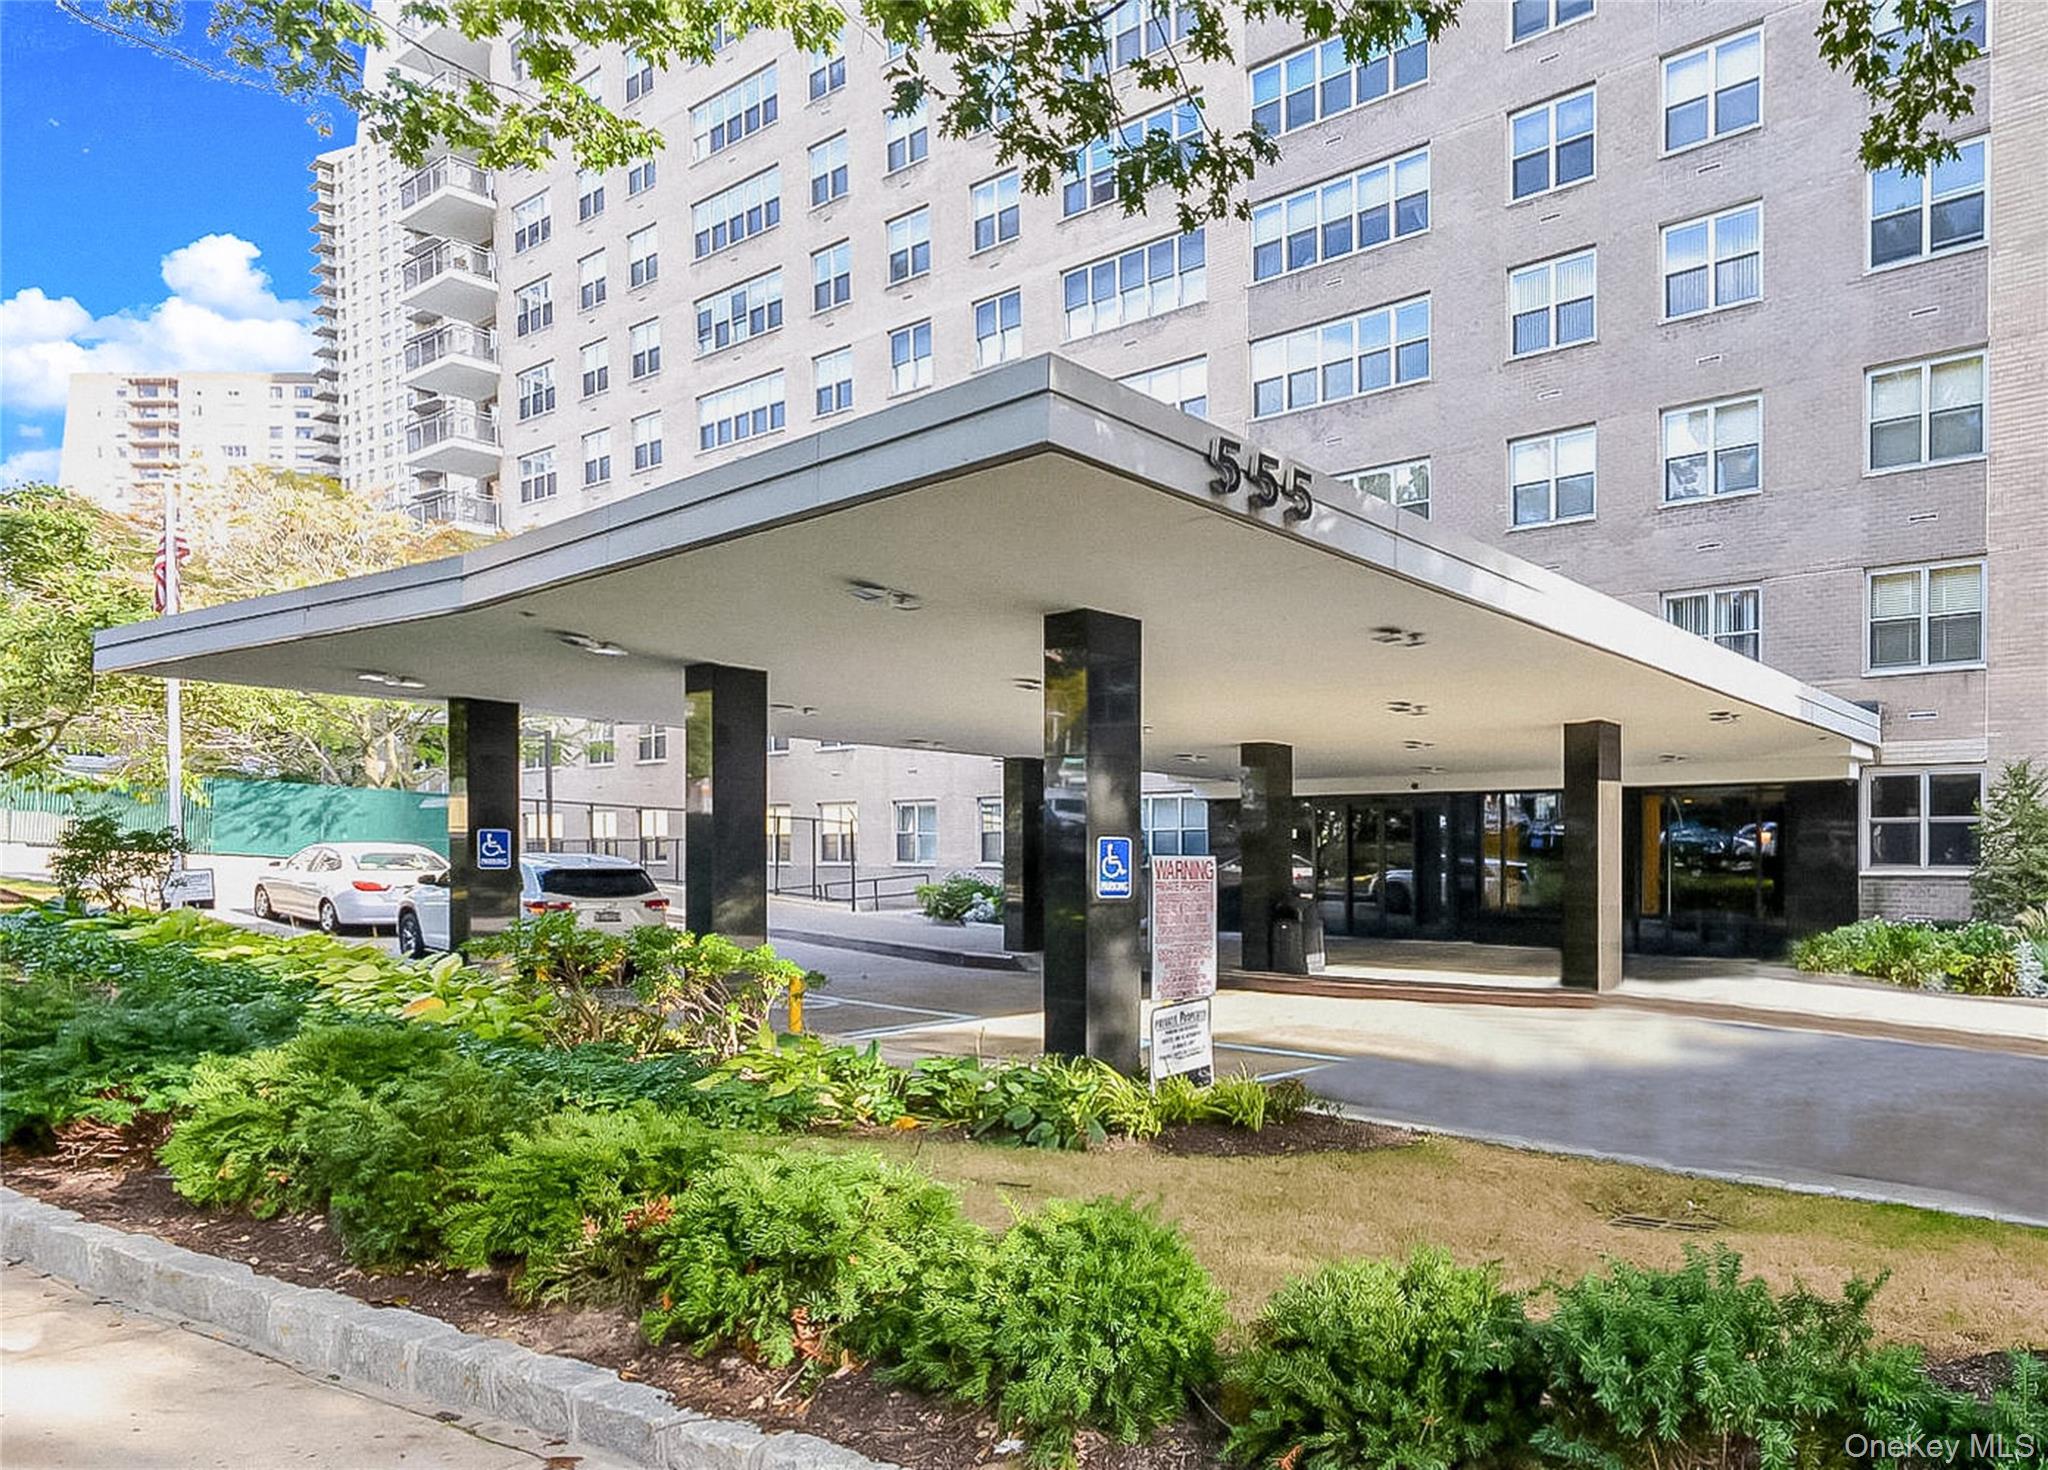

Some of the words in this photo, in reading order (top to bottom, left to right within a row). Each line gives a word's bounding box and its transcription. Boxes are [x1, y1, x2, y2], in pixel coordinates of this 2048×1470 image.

[1209, 436, 1313, 521] 555
[1154, 860, 1214, 880] WARNING
[1101, 881, 1129, 892] PARKING
